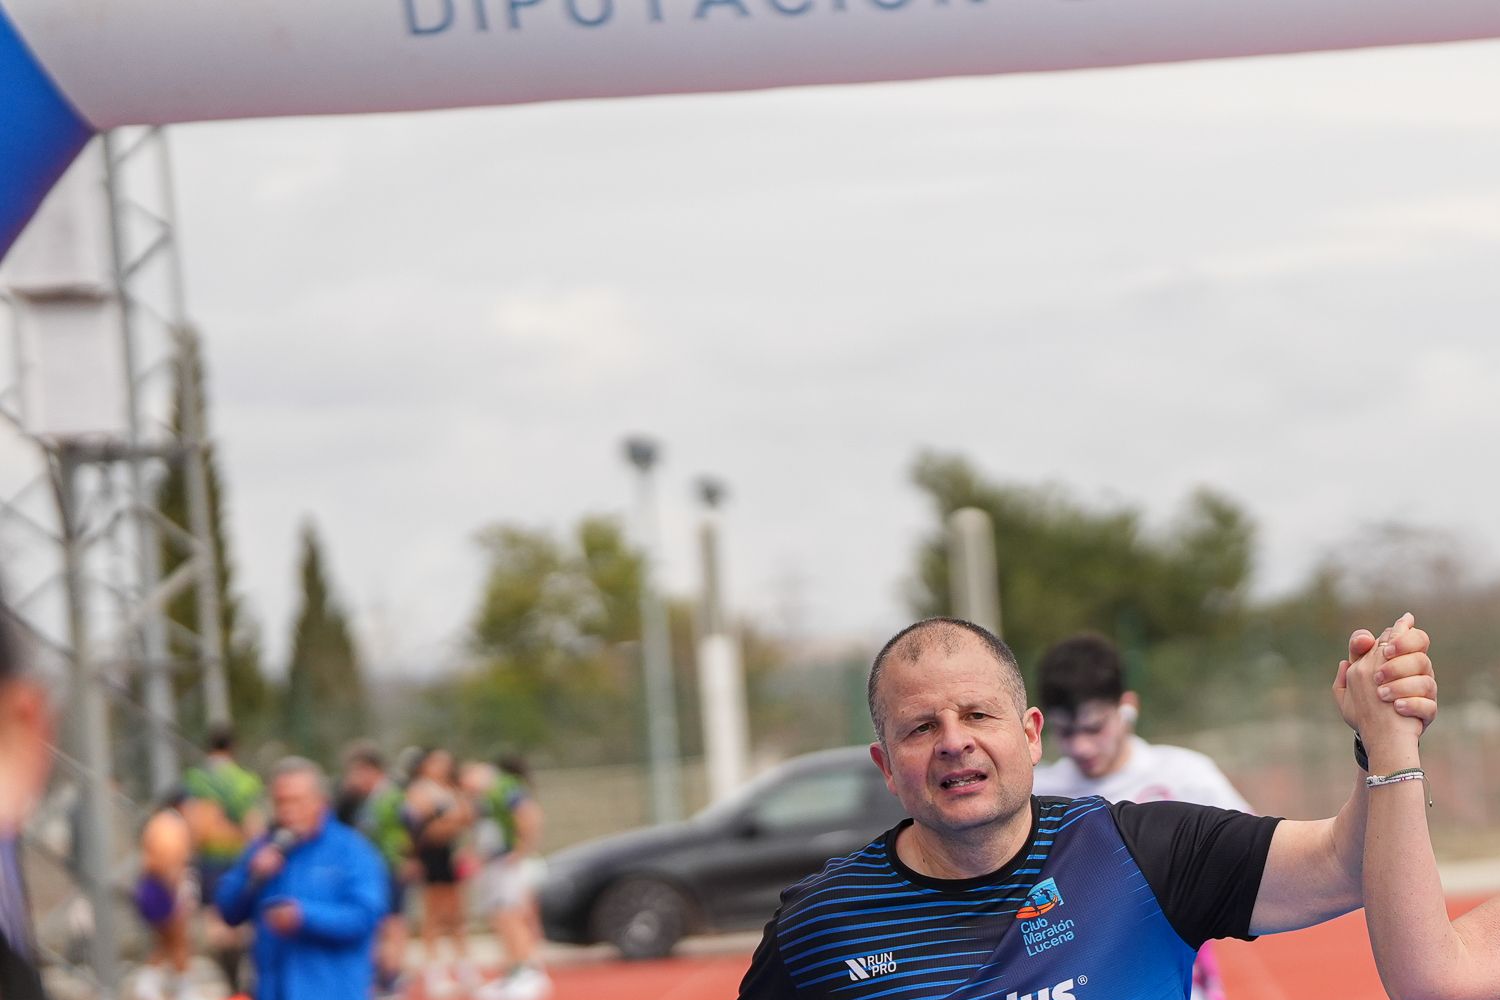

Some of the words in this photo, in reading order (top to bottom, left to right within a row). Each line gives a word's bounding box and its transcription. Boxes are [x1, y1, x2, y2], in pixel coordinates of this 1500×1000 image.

[1020, 918, 1048, 934] Club
[1023, 919, 1075, 946] Maratón
[1026, 931, 1075, 957] Lucena
[867, 951, 893, 967] RUN
[872, 961, 897, 977] PRO
